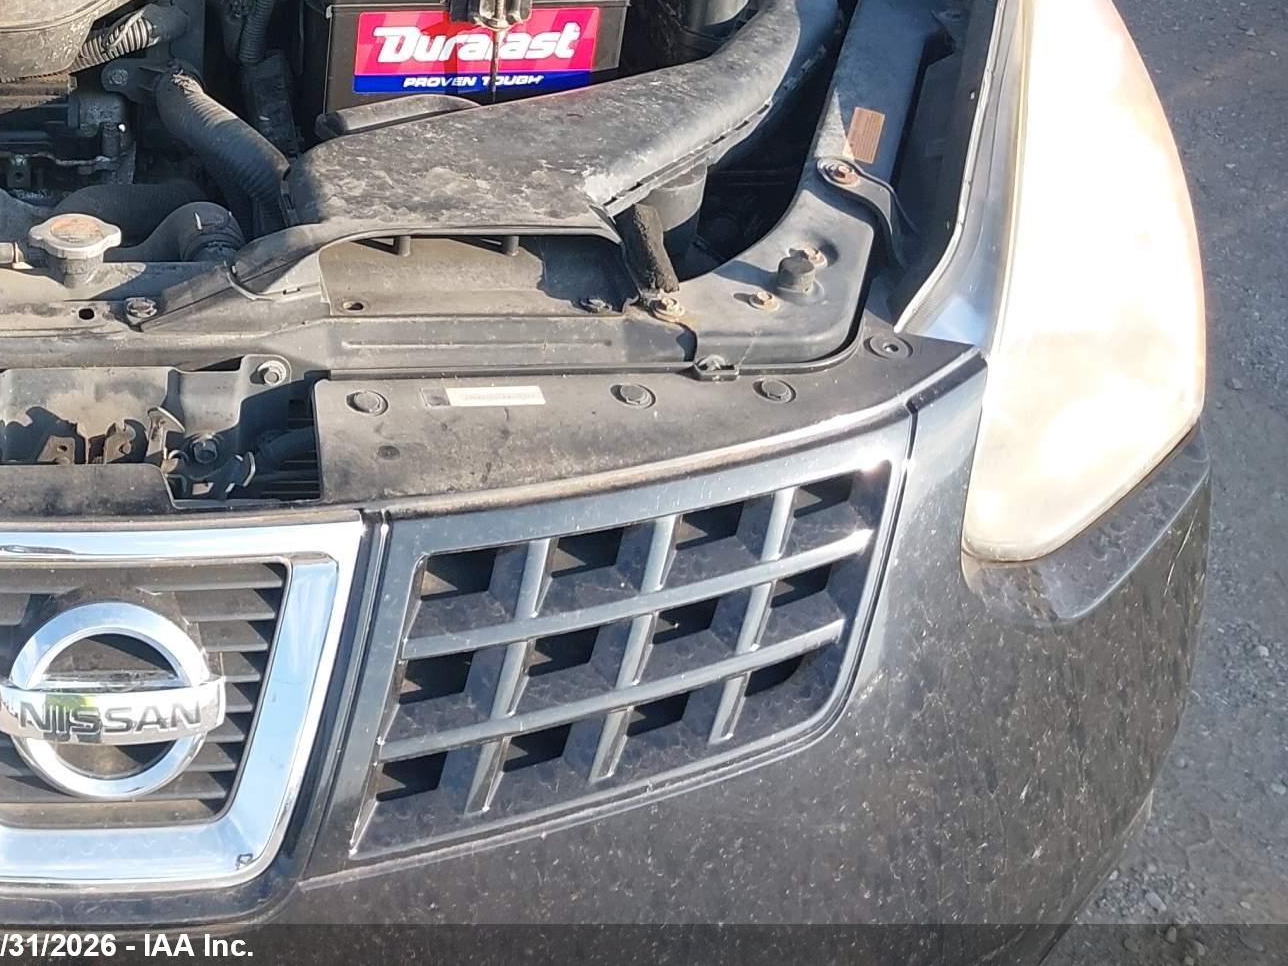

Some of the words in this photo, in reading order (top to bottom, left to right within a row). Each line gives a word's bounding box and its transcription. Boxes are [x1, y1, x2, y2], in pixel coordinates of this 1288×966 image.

[402, 76, 478, 88] PROVEN
[481, 74, 545, 88] TOUGH
[17, 700, 202, 735] NISSAN
